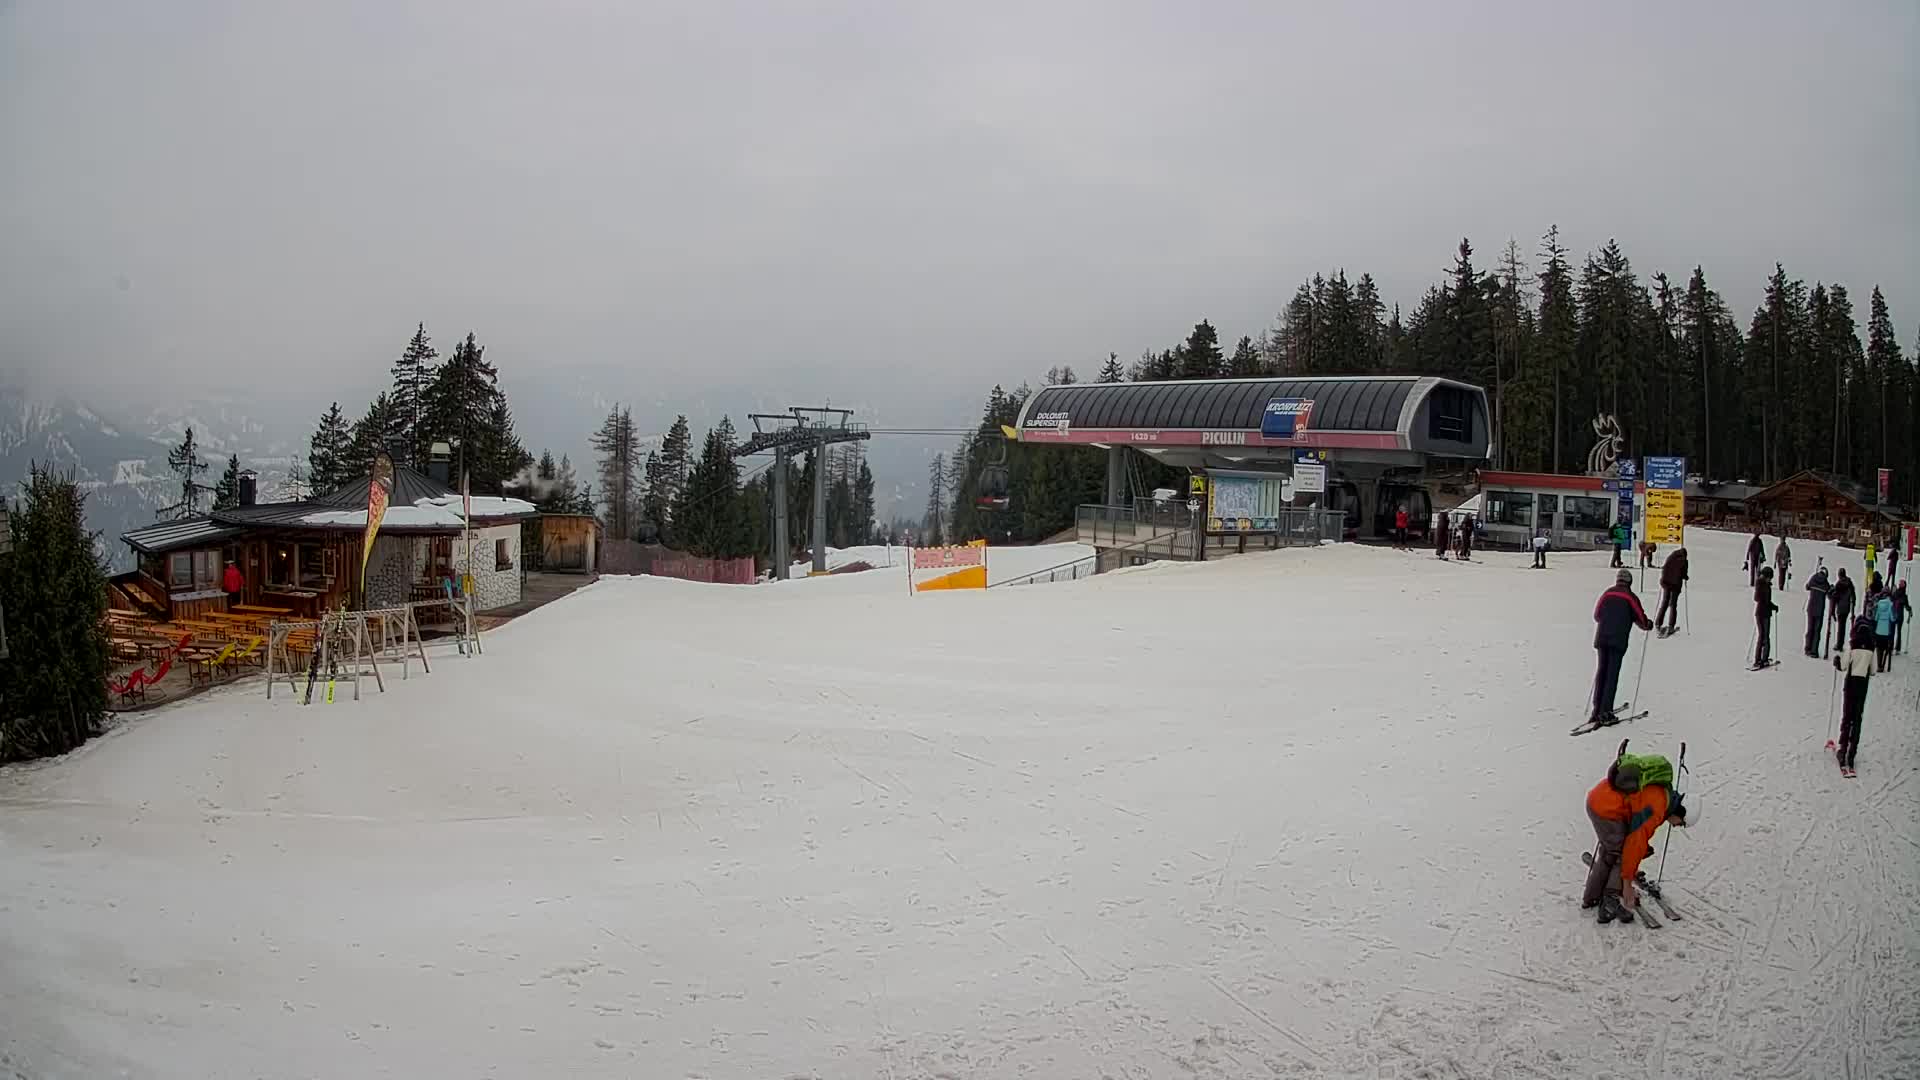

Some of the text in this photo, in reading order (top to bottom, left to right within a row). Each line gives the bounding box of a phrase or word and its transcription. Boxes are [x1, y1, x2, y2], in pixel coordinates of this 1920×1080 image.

[1266, 402, 1312, 411] KRONPLATZ
[1025, 419, 1058, 427] SUPERSKI
[1202, 432, 1245, 445] PICULIN
